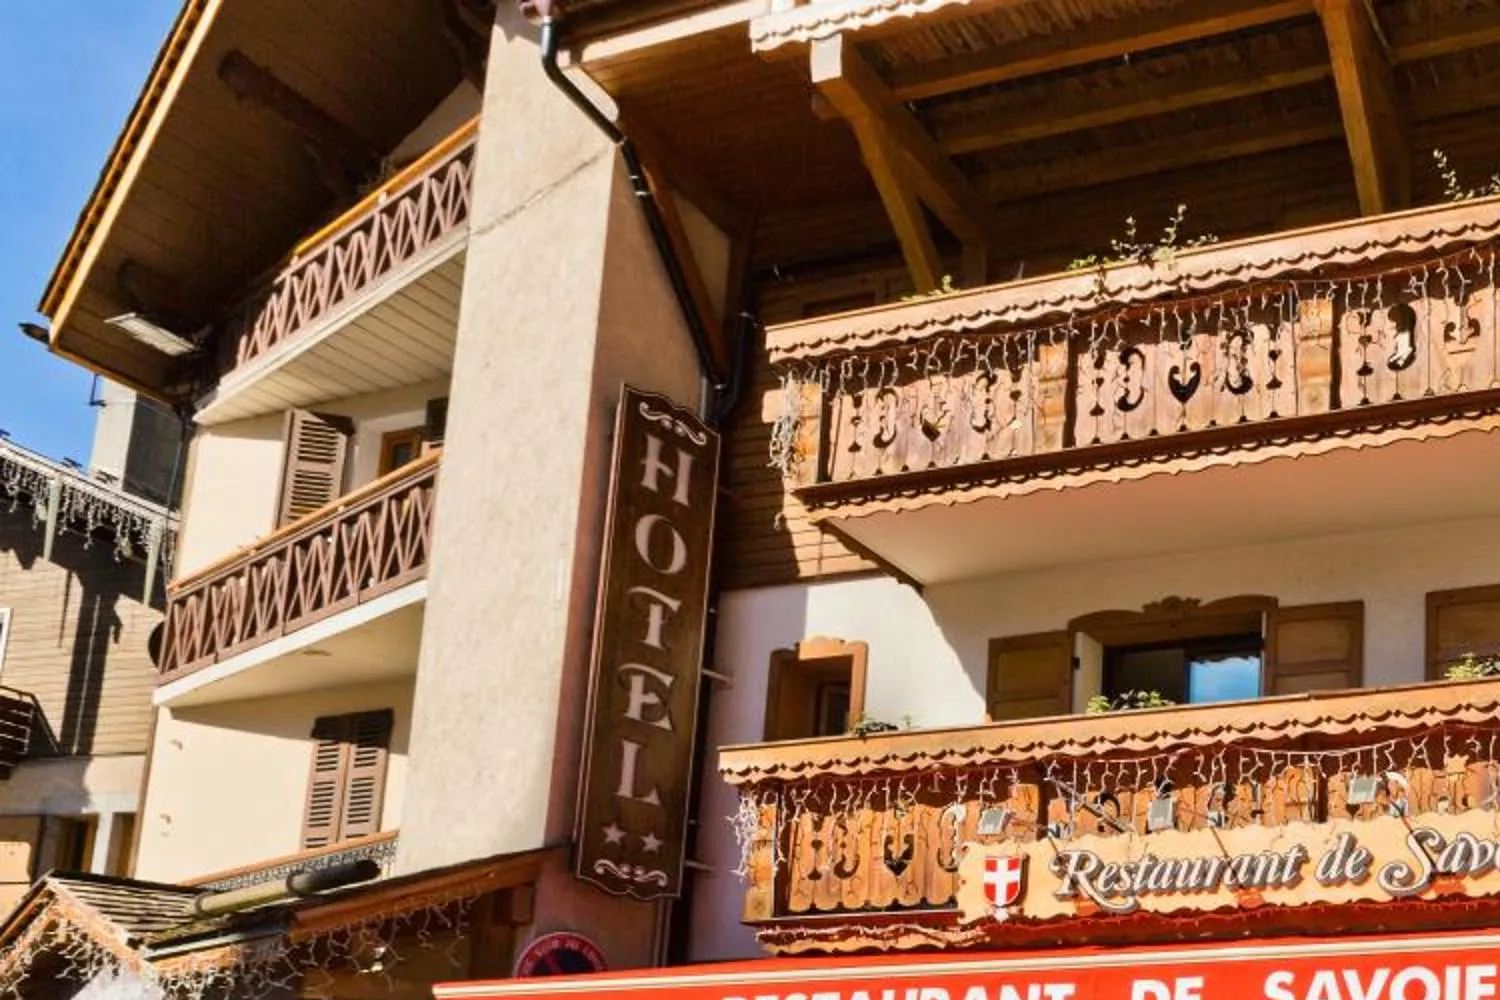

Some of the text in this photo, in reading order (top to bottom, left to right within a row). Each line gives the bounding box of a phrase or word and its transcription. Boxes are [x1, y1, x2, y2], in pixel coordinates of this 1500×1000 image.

[616, 434, 696, 806] HOTEL
[1048, 845, 1305, 912] Restaurant
[1315, 832, 1371, 886] de
